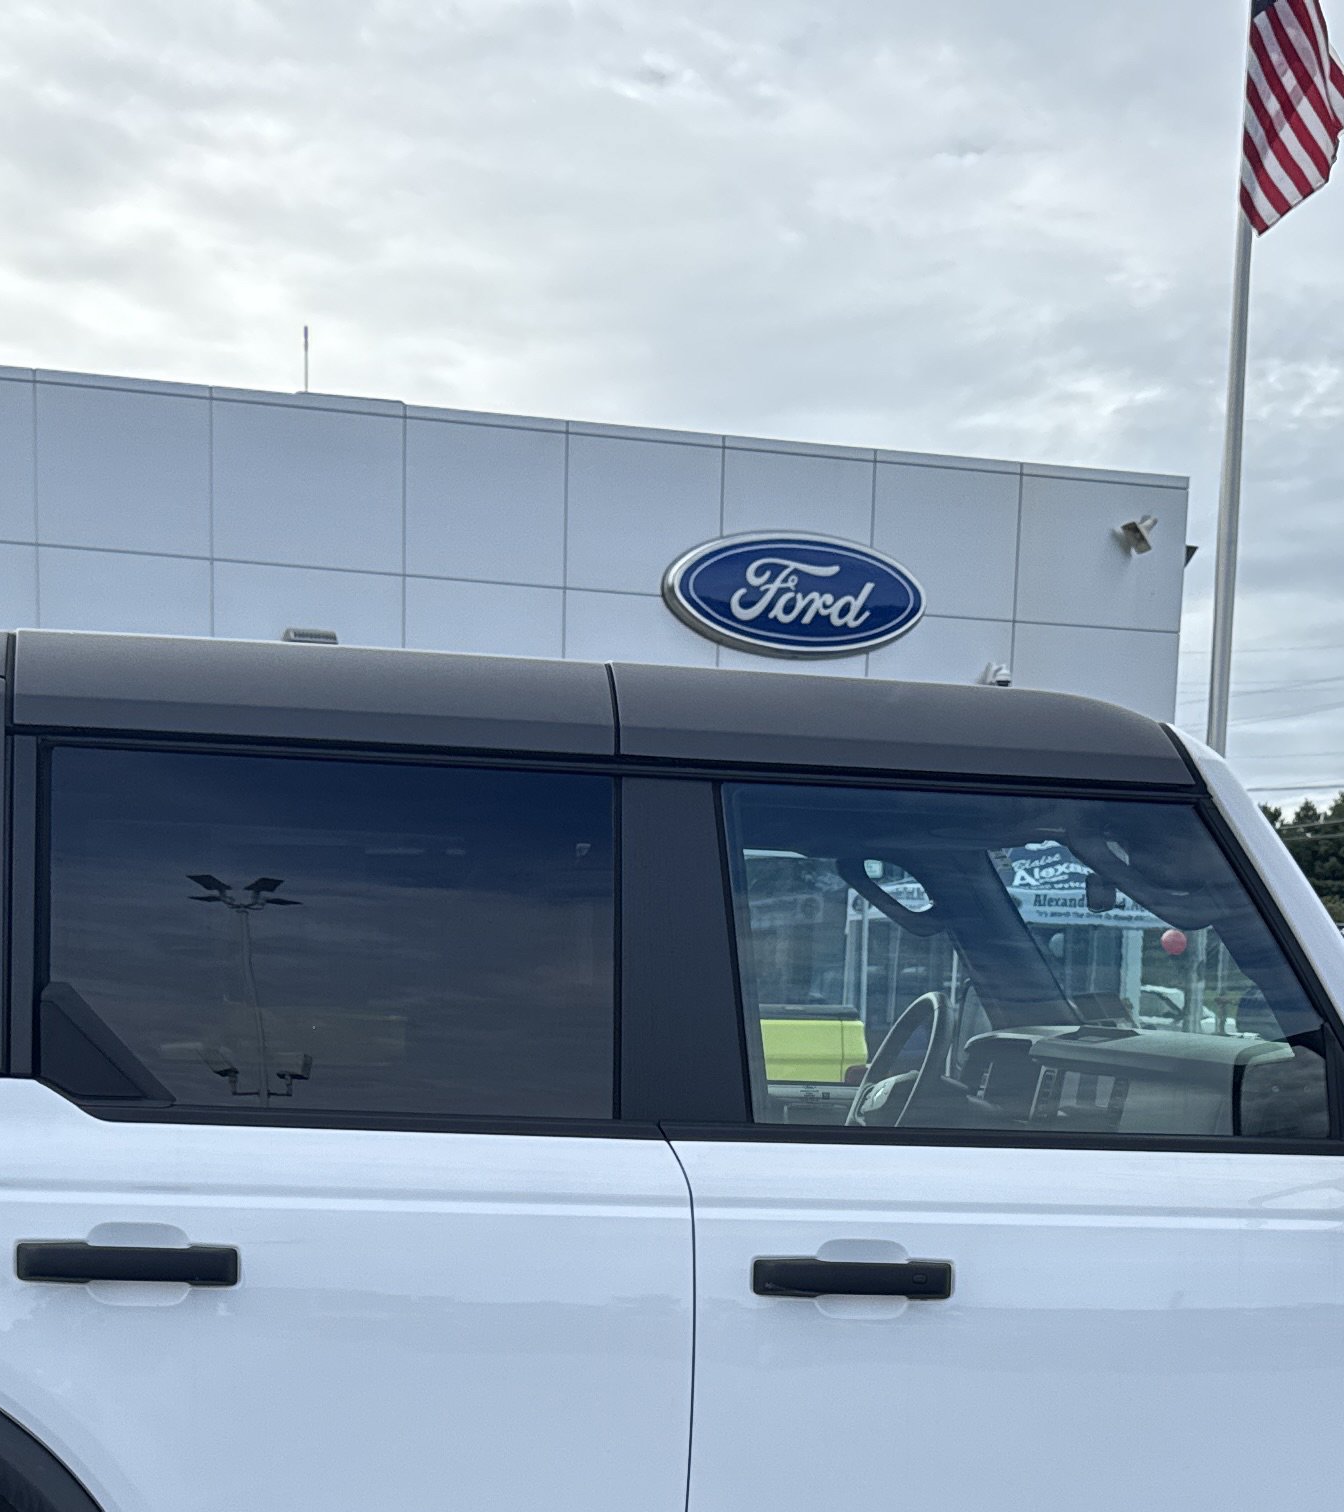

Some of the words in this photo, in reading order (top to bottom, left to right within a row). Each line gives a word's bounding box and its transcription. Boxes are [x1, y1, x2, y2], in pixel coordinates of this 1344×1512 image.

[730, 557, 876, 628] Ford
[1012, 862, 1096, 886] Alexan
[1033, 894, 1087, 908] Alexand
